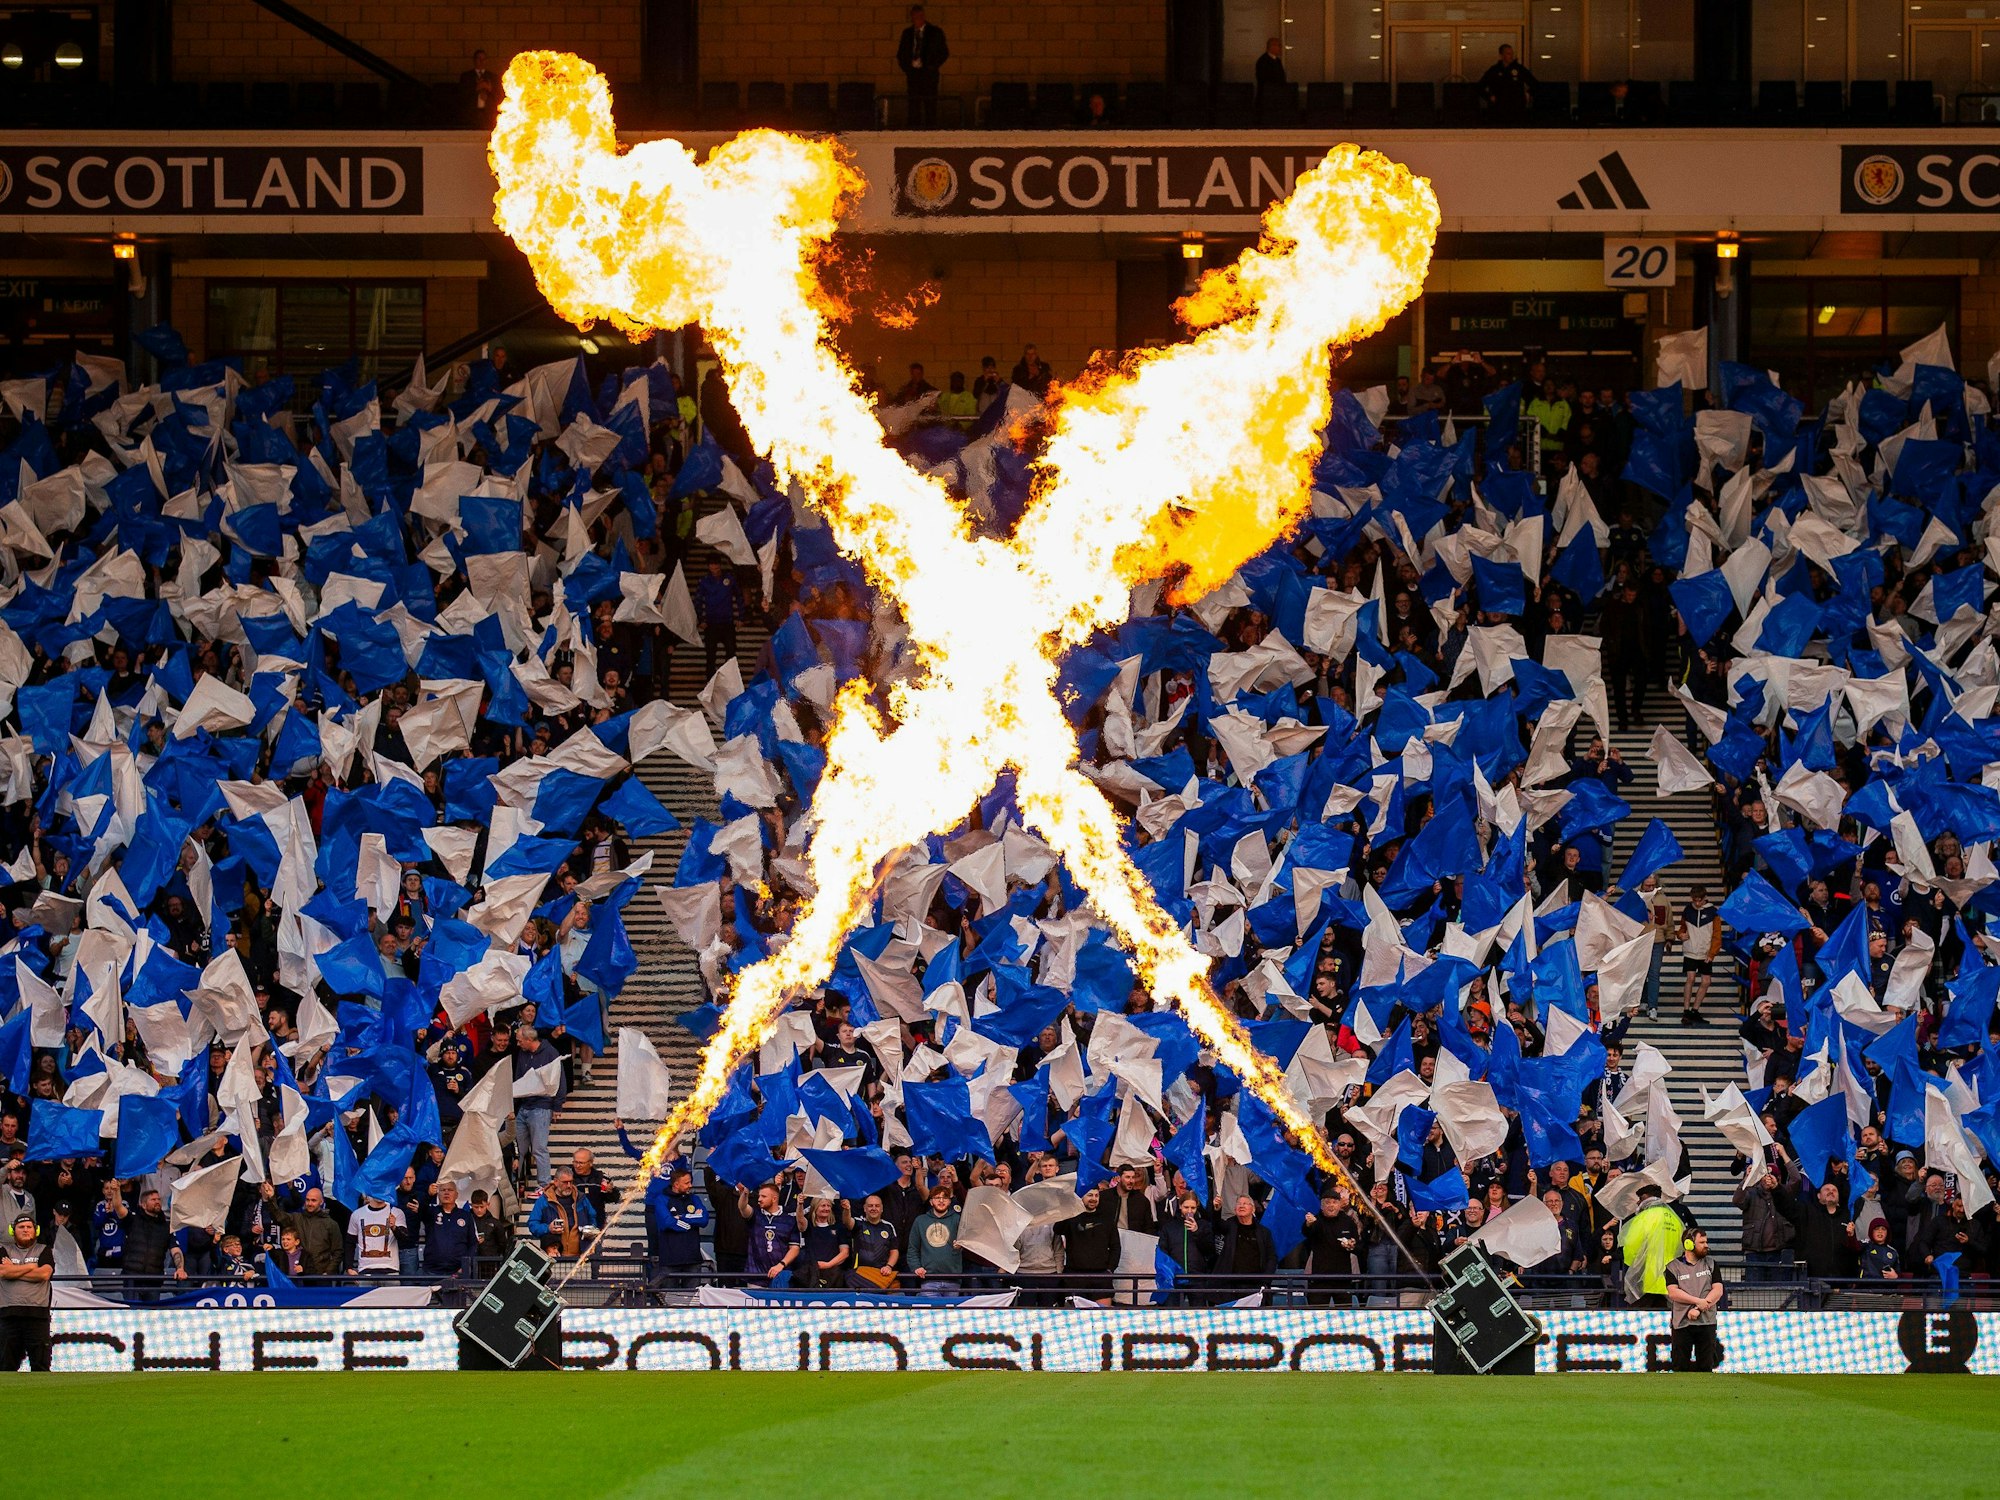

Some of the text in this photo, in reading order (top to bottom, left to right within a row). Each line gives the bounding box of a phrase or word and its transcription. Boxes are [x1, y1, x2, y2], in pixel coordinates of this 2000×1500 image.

[25, 156, 406, 209] SCOTLAND
[969, 155, 1327, 209] SCOTLAN
[1917, 154, 2000, 207] SC
[1610, 244, 1669, 280] 20
[0, 280, 39, 298] EXIT
[73, 300, 101, 312] EXIT
[1512, 301, 1556, 317] EXIT
[1480, 318, 1507, 329] EXIT
[1589, 318, 1616, 329] EXIT
[104, 1223, 114, 1231] BT
